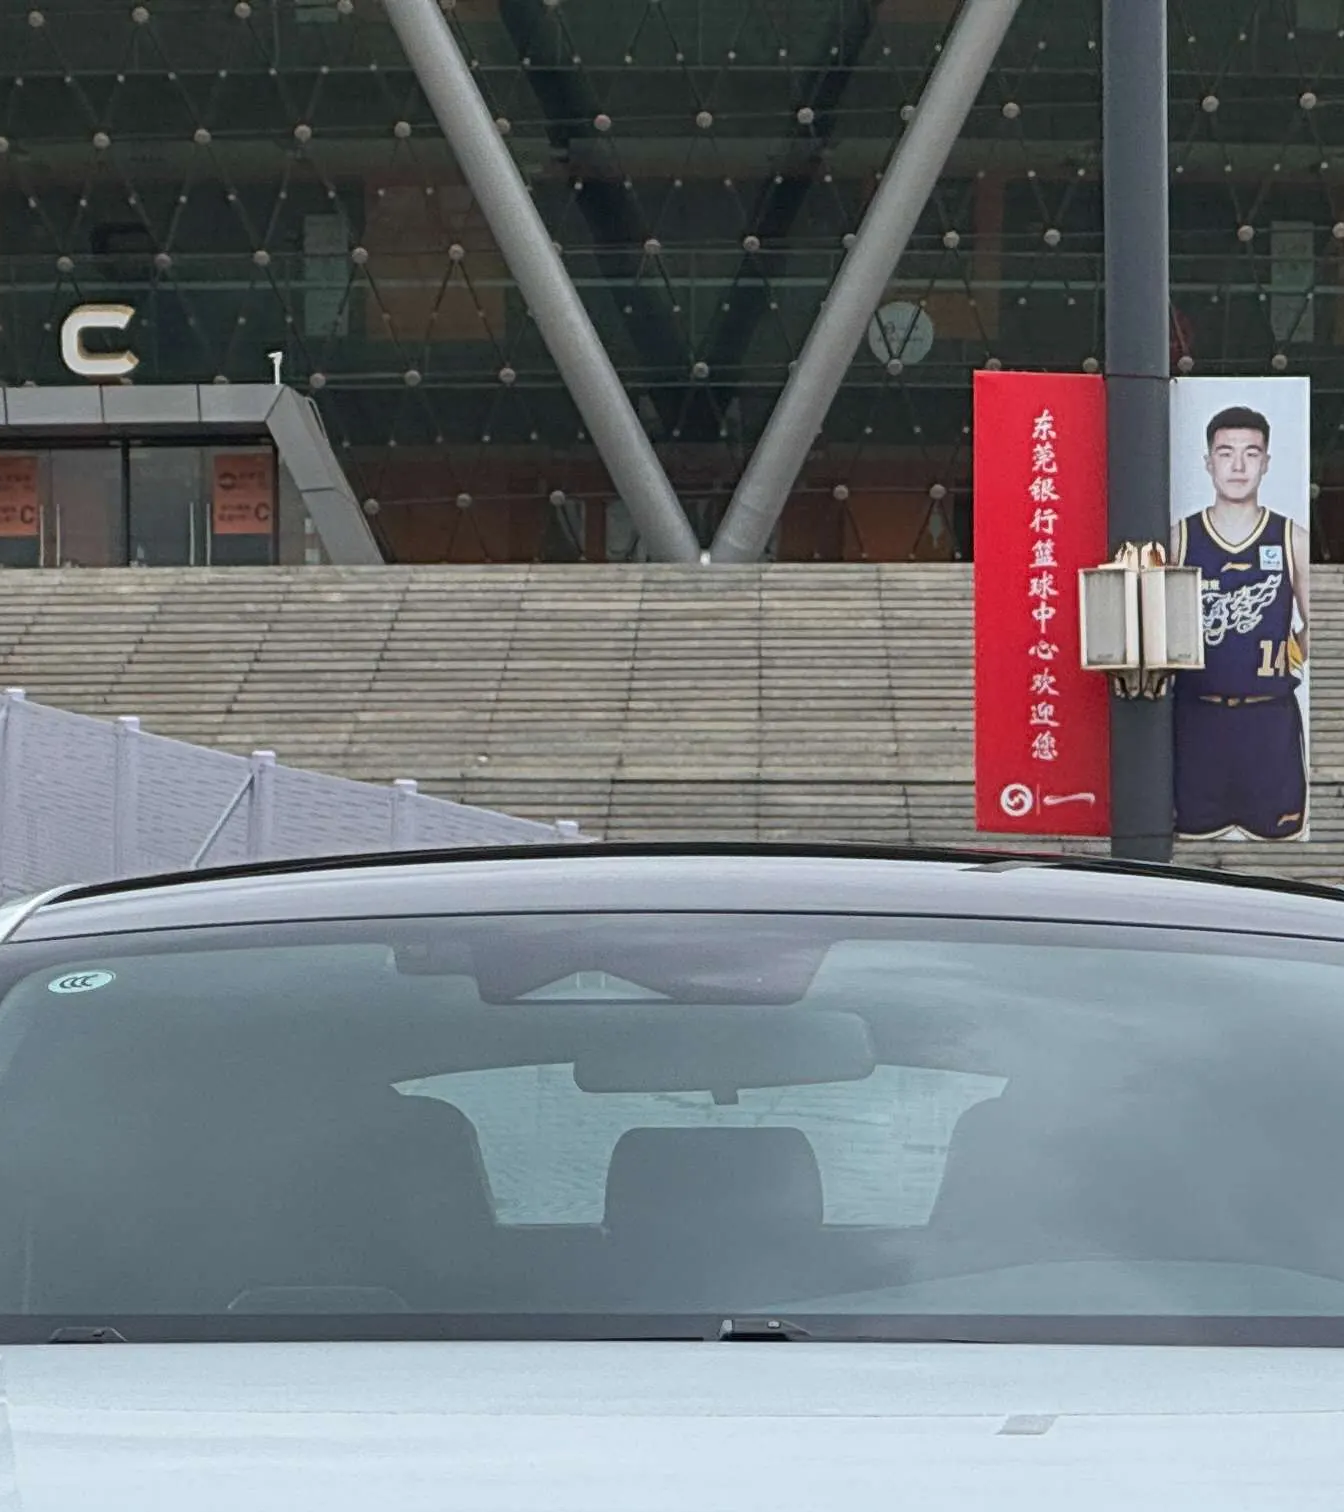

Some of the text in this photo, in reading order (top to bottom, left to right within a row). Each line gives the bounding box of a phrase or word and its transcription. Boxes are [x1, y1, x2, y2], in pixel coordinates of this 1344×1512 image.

[61, 304, 139, 375] C
[21, 505, 35, 524] C
[254, 502, 270, 522] C
[1028, 408, 1060, 762] 东莞银行篮球中心欢迎您
[1257, 640, 1287, 677] 14
